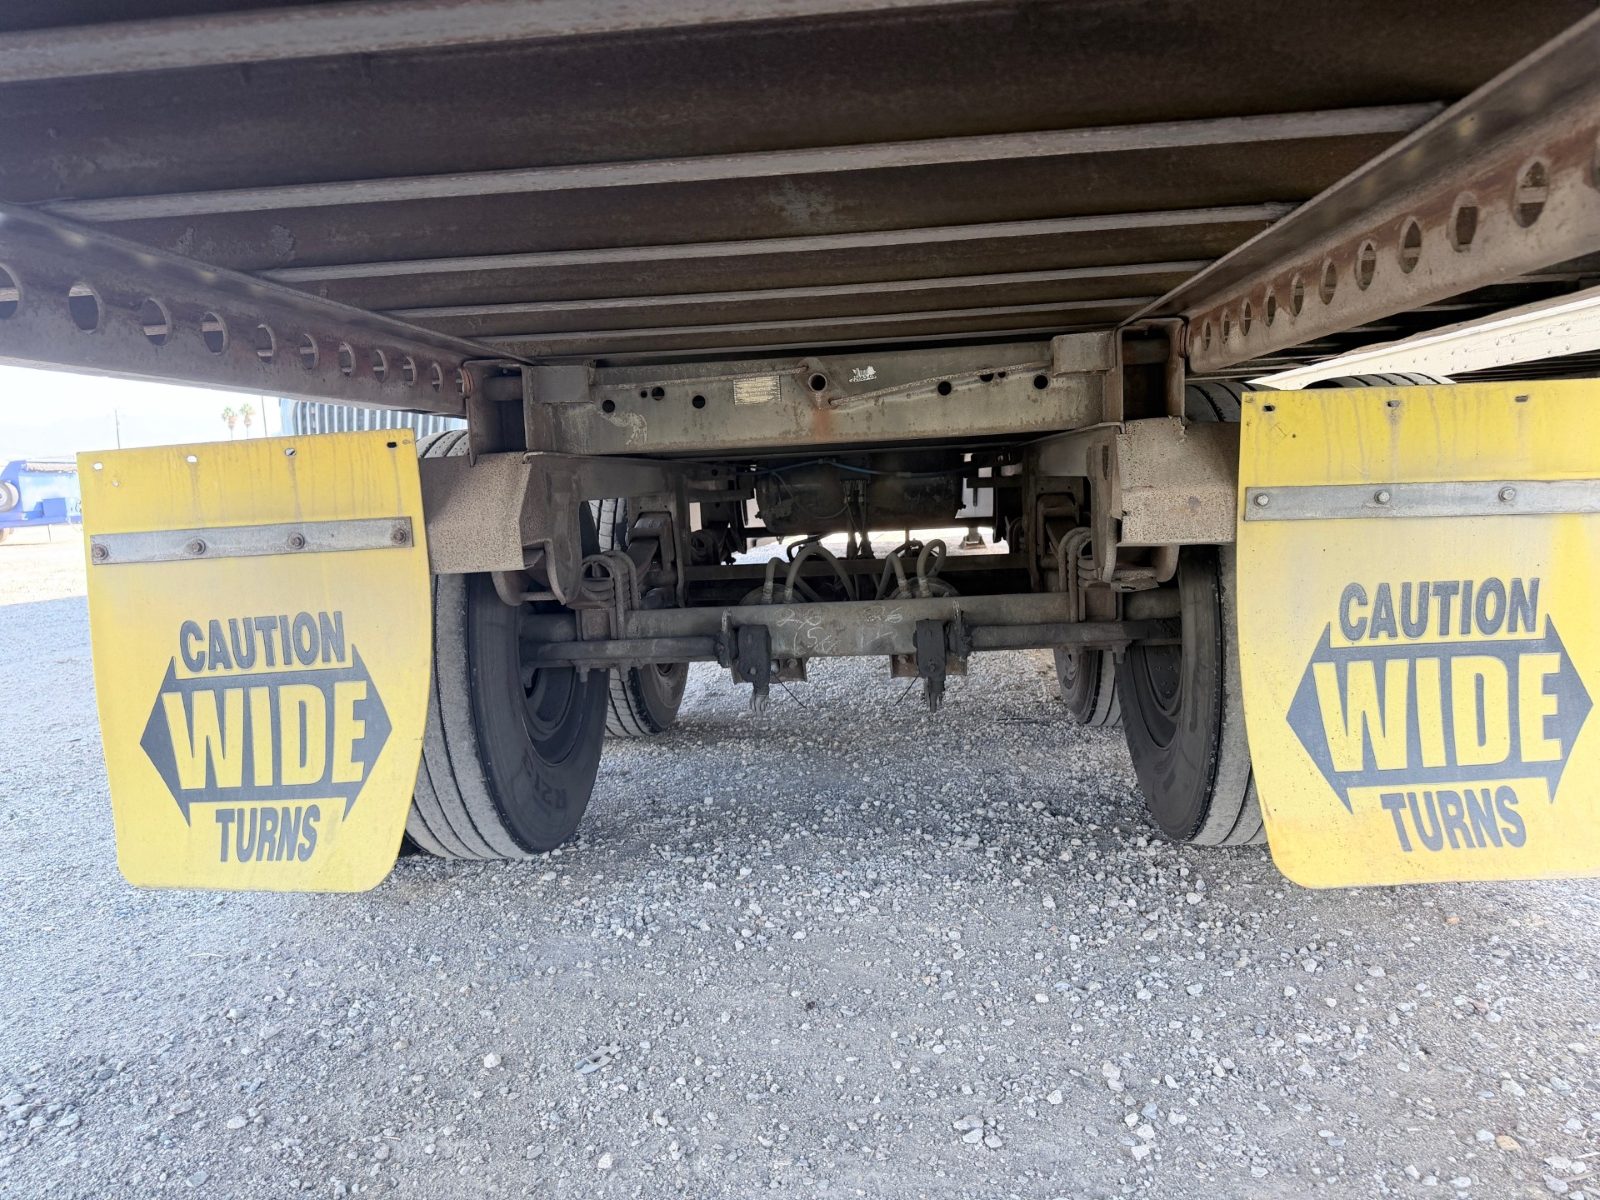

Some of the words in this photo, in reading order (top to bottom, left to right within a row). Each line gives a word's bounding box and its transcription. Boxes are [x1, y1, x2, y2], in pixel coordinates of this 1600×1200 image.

[179, 611, 346, 672] CAUTION
[1339, 577, 1540, 641] CAUTION
[161, 680, 367, 790] WIDE
[1312, 653, 1563, 773] WIDE
[215, 805, 320, 862] TURNS
[1380, 786, 1527, 852] TURNS
